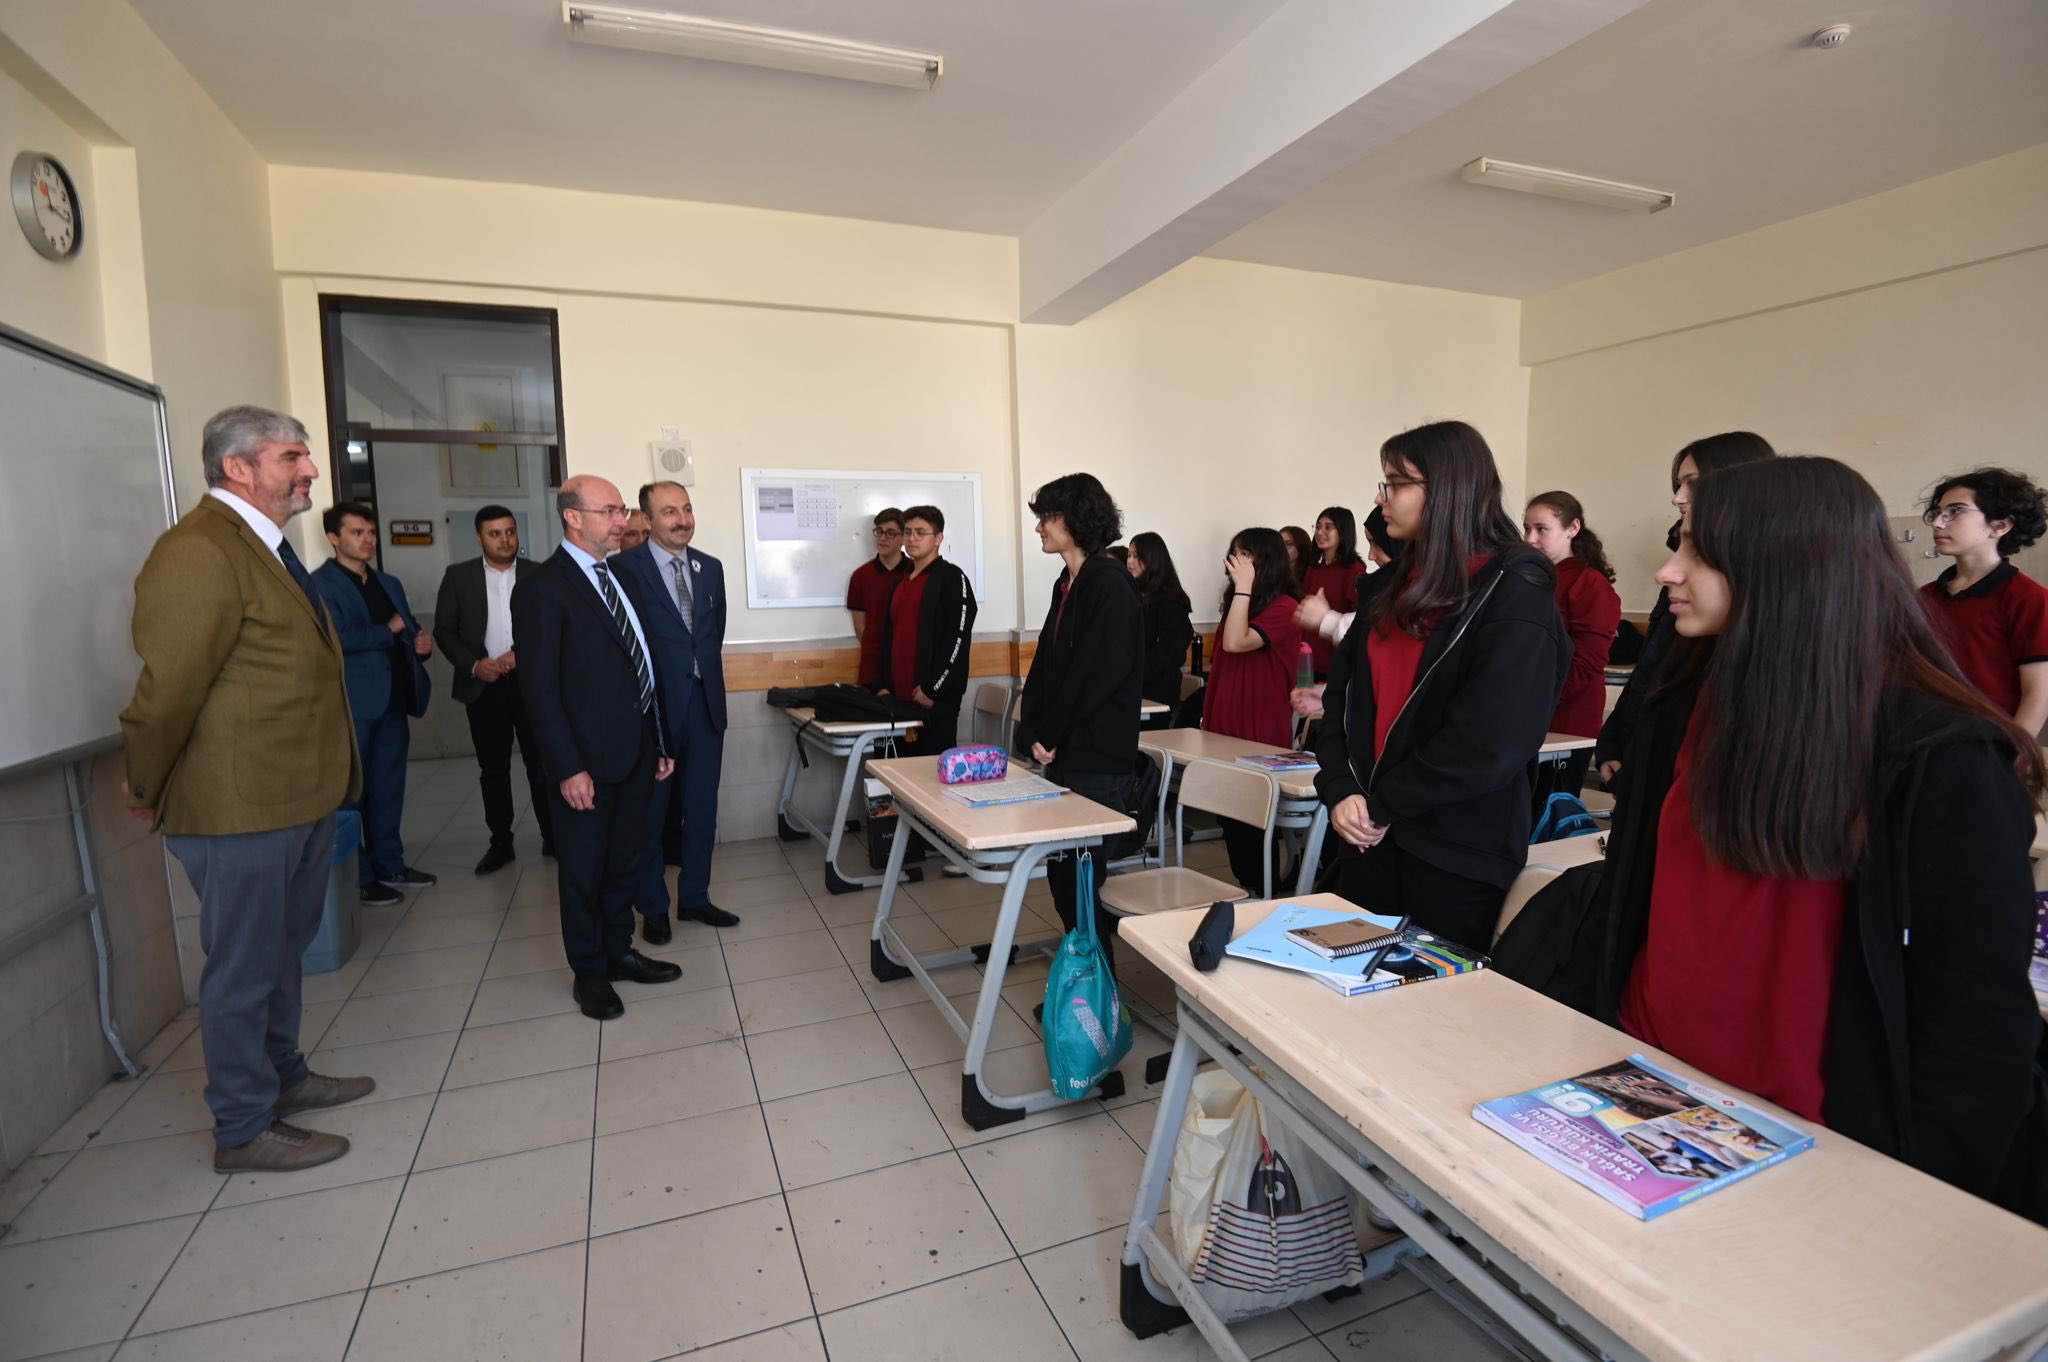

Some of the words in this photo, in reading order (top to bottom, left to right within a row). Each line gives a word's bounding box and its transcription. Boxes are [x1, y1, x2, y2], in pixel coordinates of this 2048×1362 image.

[1069, 1076, 1089, 1088] feel
[1510, 1111, 1532, 1124] VE
[1527, 1108, 1592, 1144] KÜLTÜRÜ
[1529, 1121, 1582, 1151] BİLGİSİ
[1580, 1148, 1638, 1183] SAĞLIK
[1590, 1141, 1646, 1174] TRAFİK
